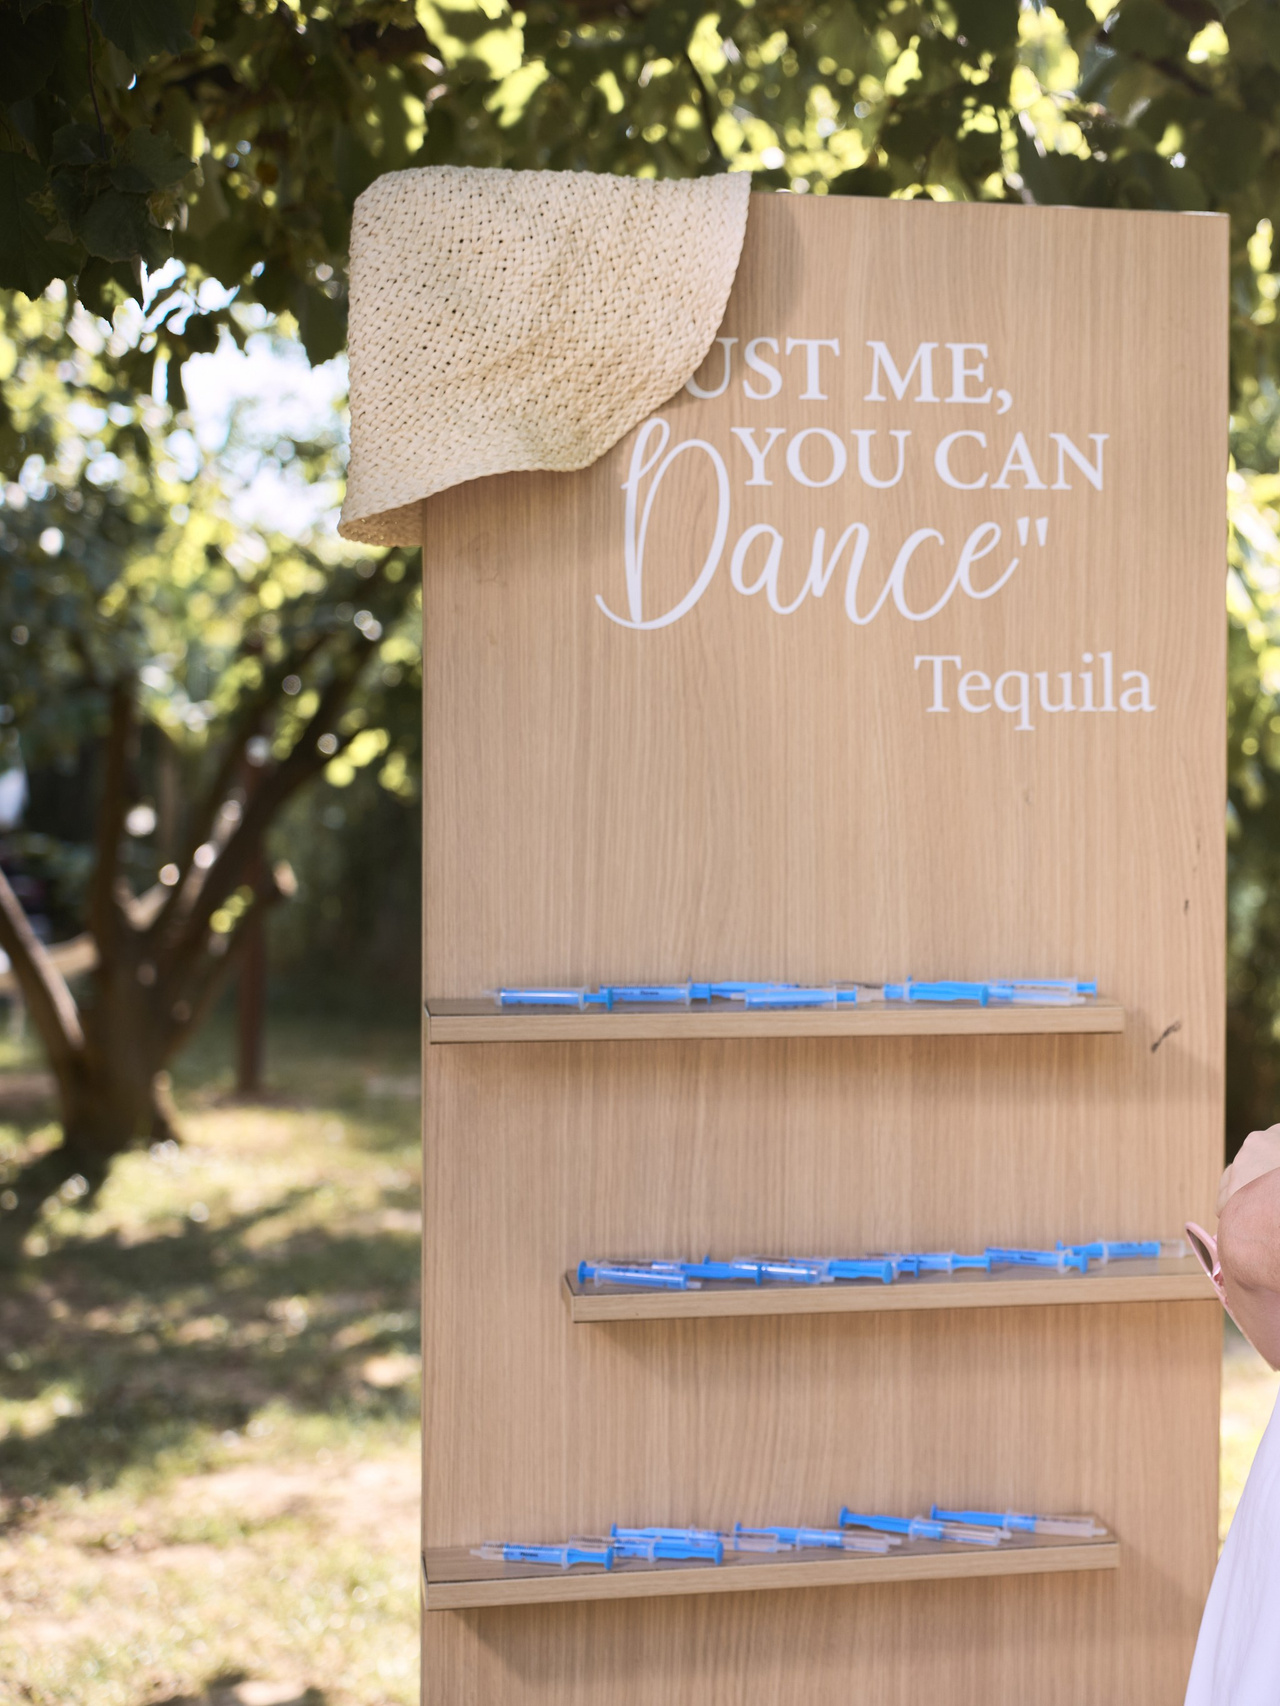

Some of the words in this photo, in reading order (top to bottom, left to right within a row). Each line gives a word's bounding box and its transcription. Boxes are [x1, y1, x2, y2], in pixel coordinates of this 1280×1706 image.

[684, 336, 841, 401] UST
[863, 339, 1014, 415] ME,
[730, 426, 912, 489] YOU
[933, 430, 1111, 492] CAN
[594, 417, 1049, 630] Dance"
[913, 650, 1157, 731] Tequila
